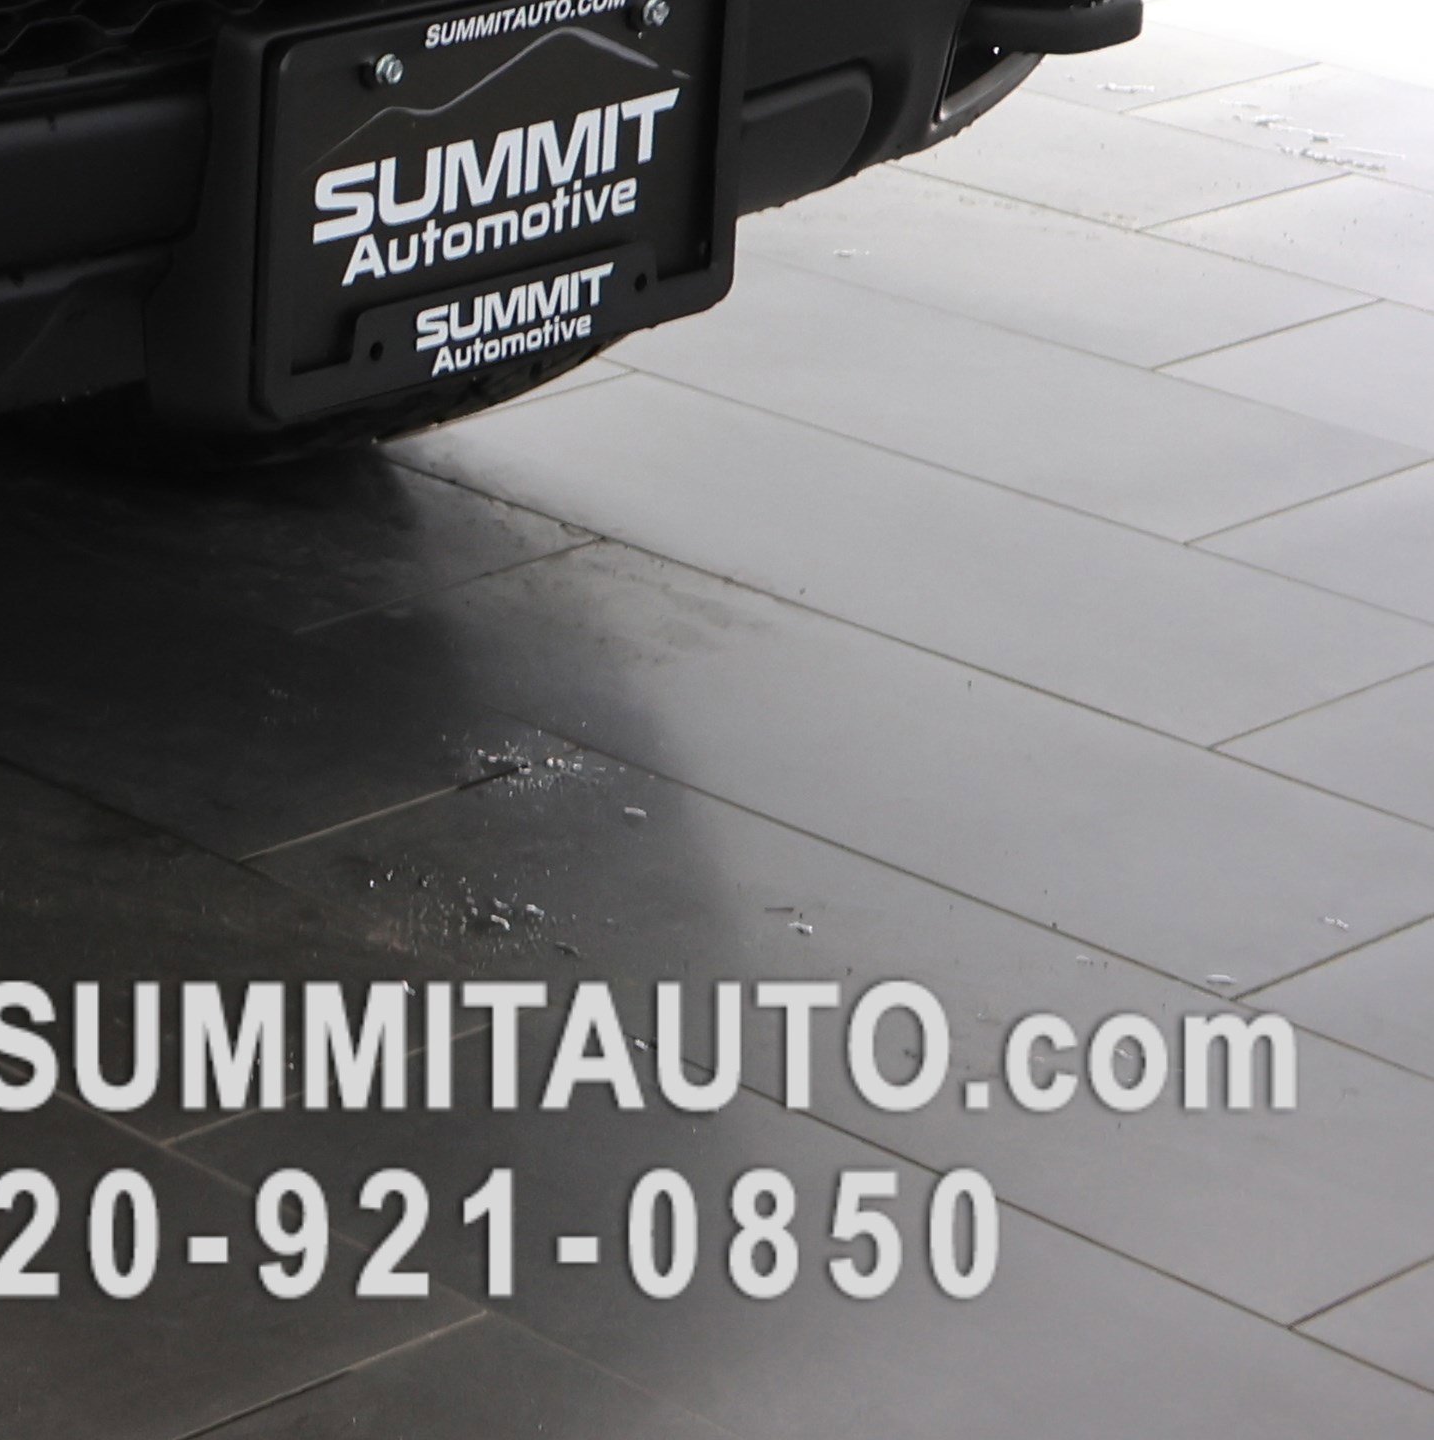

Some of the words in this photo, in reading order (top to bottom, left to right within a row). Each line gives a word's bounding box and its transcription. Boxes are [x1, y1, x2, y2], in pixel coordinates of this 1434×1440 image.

[313, 88, 680, 244] SUMMIT
[341, 175, 638, 287] Automotive
[415, 262, 614, 351] SUMMIT
[431, 311, 593, 377] Automotive
